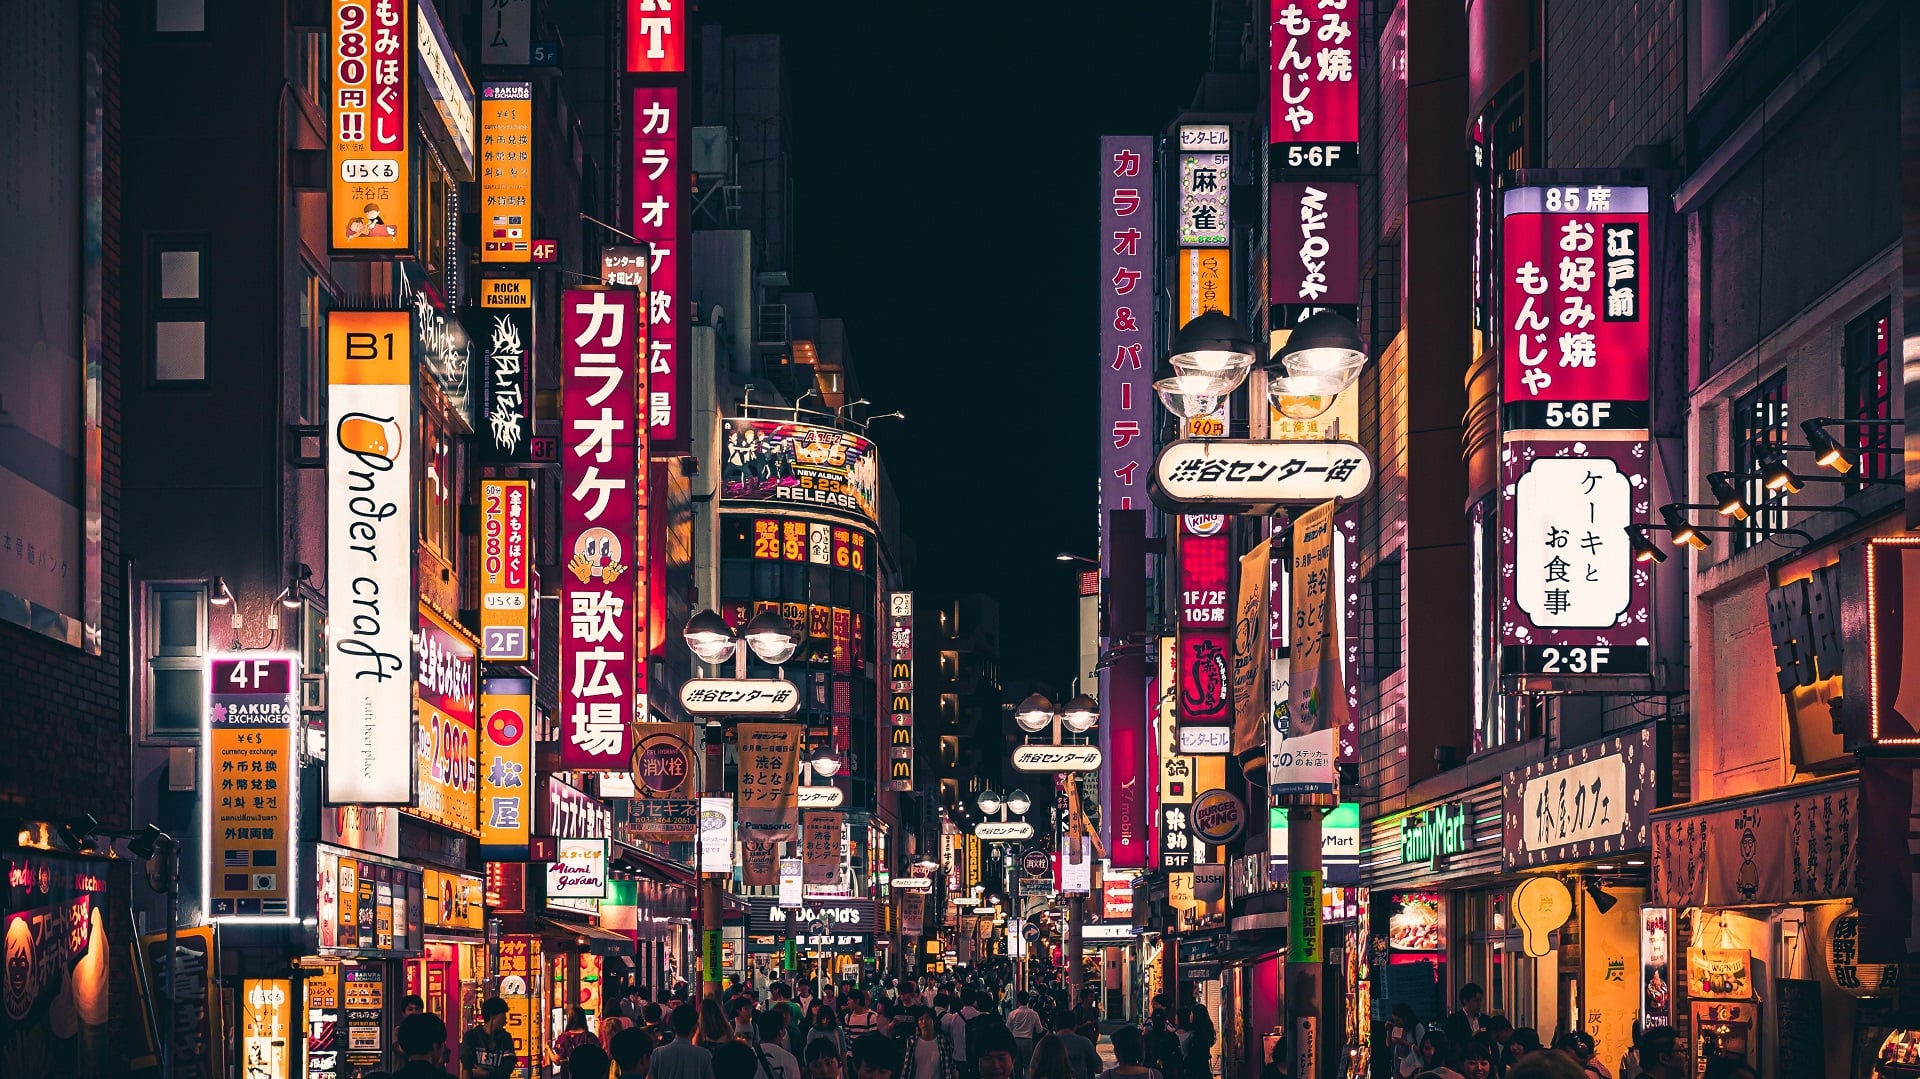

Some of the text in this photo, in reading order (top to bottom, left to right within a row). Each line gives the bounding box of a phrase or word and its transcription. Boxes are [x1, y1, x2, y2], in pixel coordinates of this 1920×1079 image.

[1278, 3, 1314, 131] もんじゃ
[1181, 132, 1228, 145] センタービル
[1214, 155, 1229, 165] 5F
[346, 164, 394, 178] りらくる
[352, 186, 389, 200] 渋谷店
[1192, 168, 1217, 230] 麻雀
[1546, 188, 1612, 211] 85席
[533, 245, 555, 259] 4F
[1607, 227, 1635, 318] 江戸前
[494, 283, 520, 293] ROCK
[1559, 218, 1596, 362] お好み焼
[487, 295, 526, 305] FASHION
[1514, 261, 1553, 396] もんじゃ
[347, 333, 393, 361] B1
[1281, 421, 1319, 434] 北海道
[797, 469, 843, 482] NEW ALBUM
[1168, 459, 1362, 482] 渋谷センター街
[801, 476, 841, 493] 5.23
[777, 486, 857, 510] RELEASE
[570, 292, 625, 756] カラオケ 歌広場
[1580, 469, 1604, 581] ケーキと
[1542, 525, 1572, 616] お食事
[1307, 567, 1330, 598] 渋谷
[488, 596, 522, 606] りらくる
[1183, 590, 1227, 606] 1F/2F
[1184, 608, 1226, 623] 105席
[337, 577, 403, 682] craft
[490, 632, 520, 652] 2F
[229, 660, 270, 689] 4F
[687, 689, 793, 703] 渋谷センター街
[228, 703, 290, 714] SAKURA
[228, 715, 281, 724] EXCHANGE
[1181, 732, 1229, 746] センタービル
[221, 749, 278, 757] currency exchange
[1016, 752, 1099, 765] 渋谷センター街
[1295, 751, 1329, 759] ステッカー
[222, 761, 278, 772] 外币兑换
[643, 757, 684, 777] 消火栓
[755, 756, 784, 770] 渋谷
[1271, 752, 1303, 771] この
[1295, 759, 1329, 767] のお店!!
[743, 772, 796, 786] おとなり
[487, 756, 521, 828] 松屋
[742, 788, 799, 802] サンデー
[647, 802, 697, 817] セキネ
[1198, 802, 1236, 821] BURGER
[1535, 774, 1613, 847] 椿屋カフェ
[745, 821, 793, 830] Panasonic
[1200, 813, 1238, 834] KING
[224, 828, 275, 839] 外貨両替
[1400, 802, 1467, 872] FamilyMart
[806, 841, 840, 851] おとなり
[1165, 844, 1190, 867] B1F
[1195, 875, 1225, 883] SUSHI
